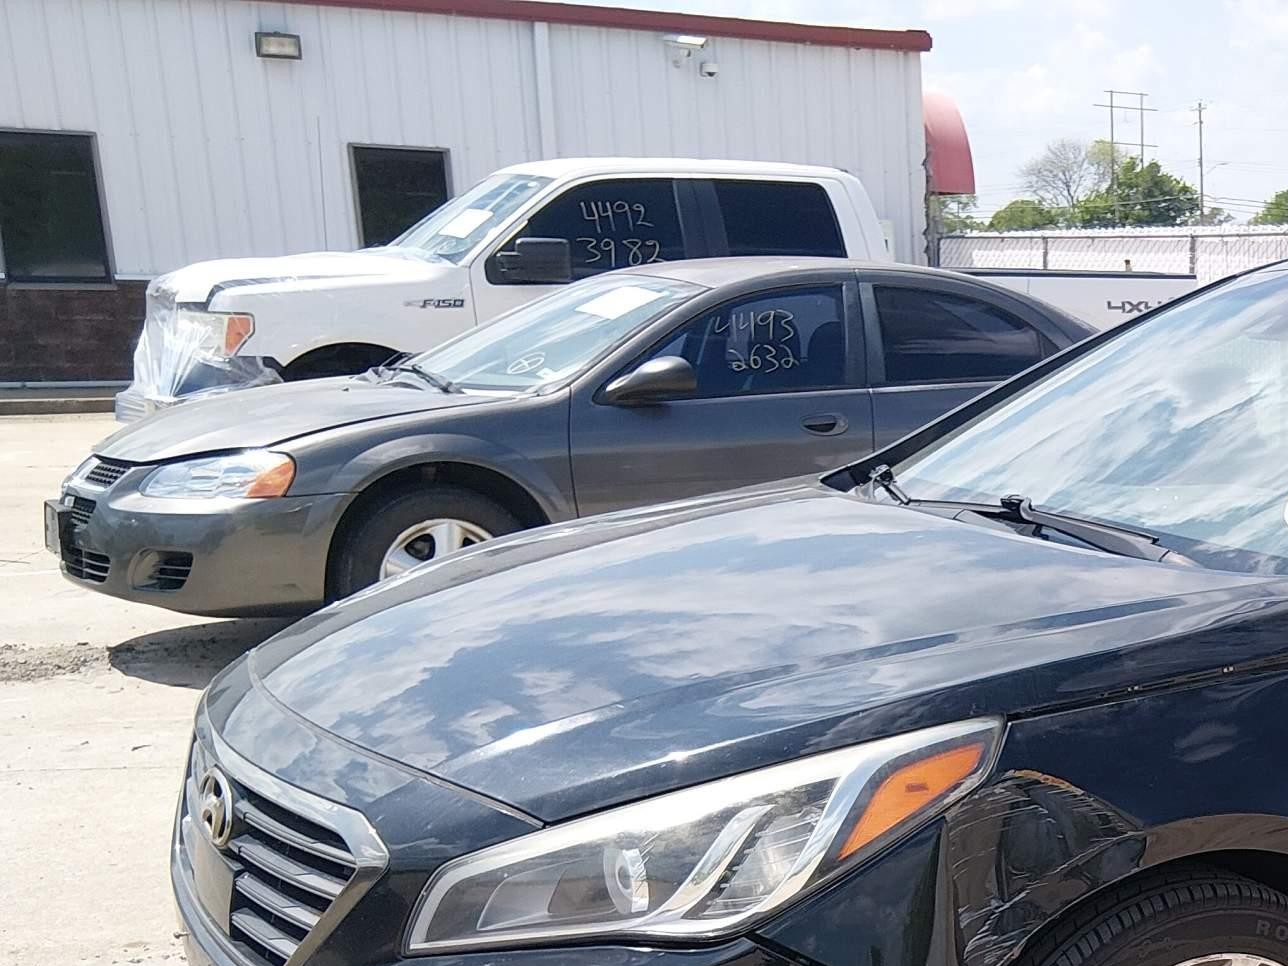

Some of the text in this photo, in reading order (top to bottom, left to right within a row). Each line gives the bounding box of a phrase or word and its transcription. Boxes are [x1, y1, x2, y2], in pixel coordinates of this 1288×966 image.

[580, 201, 655, 233] 4492
[576, 237, 665, 267] 3982
[715, 309, 794, 342] 4493
[728, 344, 800, 373] 2632
